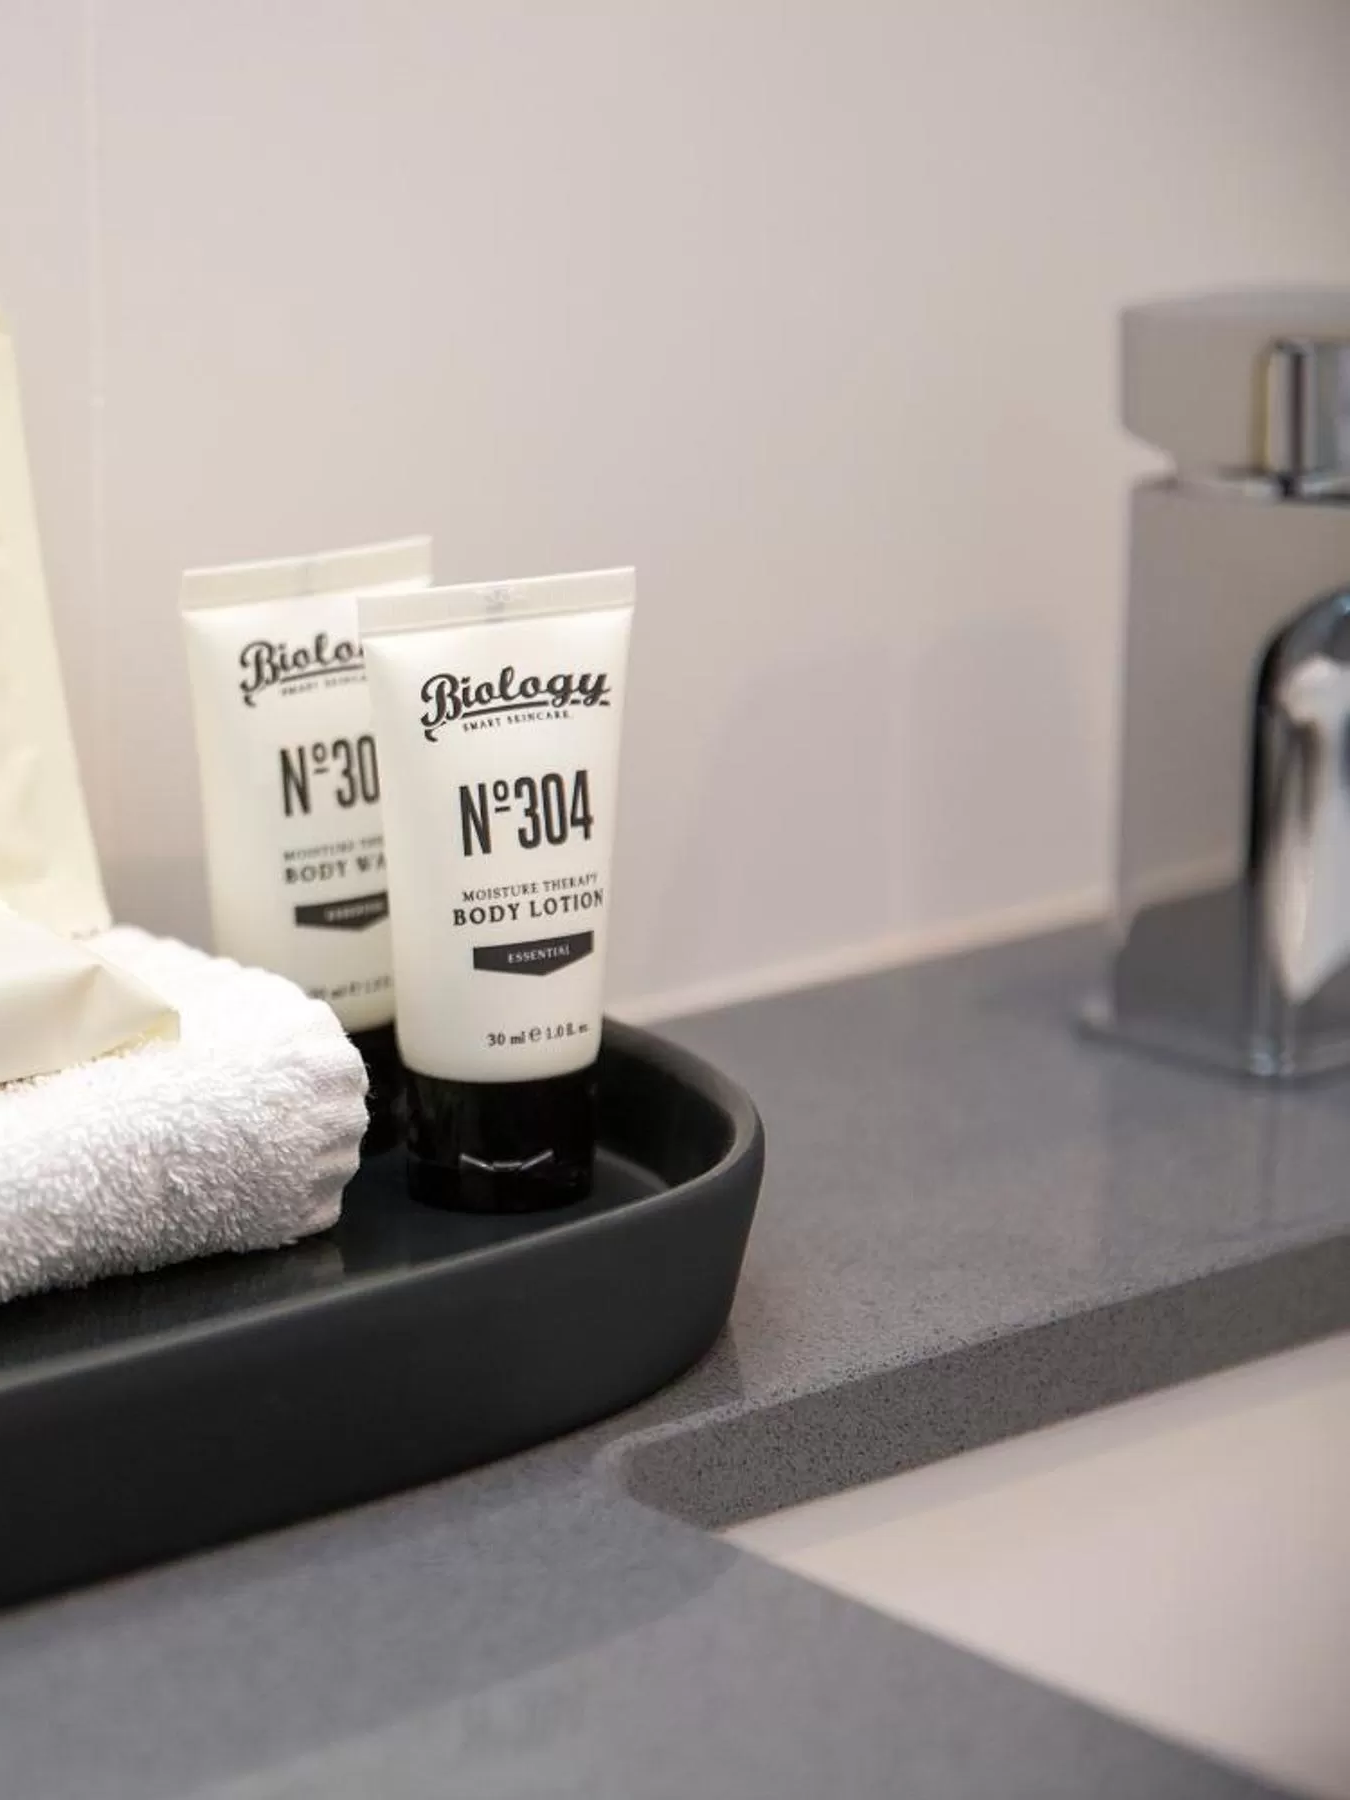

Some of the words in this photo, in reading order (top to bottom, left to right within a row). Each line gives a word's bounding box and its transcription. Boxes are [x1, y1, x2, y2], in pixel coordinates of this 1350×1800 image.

[239, 632, 367, 708] Biolo
[420, 665, 612, 742] Biology
[463, 716, 501, 733] SMART
[284, 860, 347, 885] BODY
[462, 881, 539, 902] MOISTURE
[543, 871, 598, 892] THERAPY
[453, 903, 520, 926] BODY
[530, 888, 604, 918] LOTION
[507, 943, 570, 965] ESSENTIAL
[487, 1032, 506, 1047] 30
